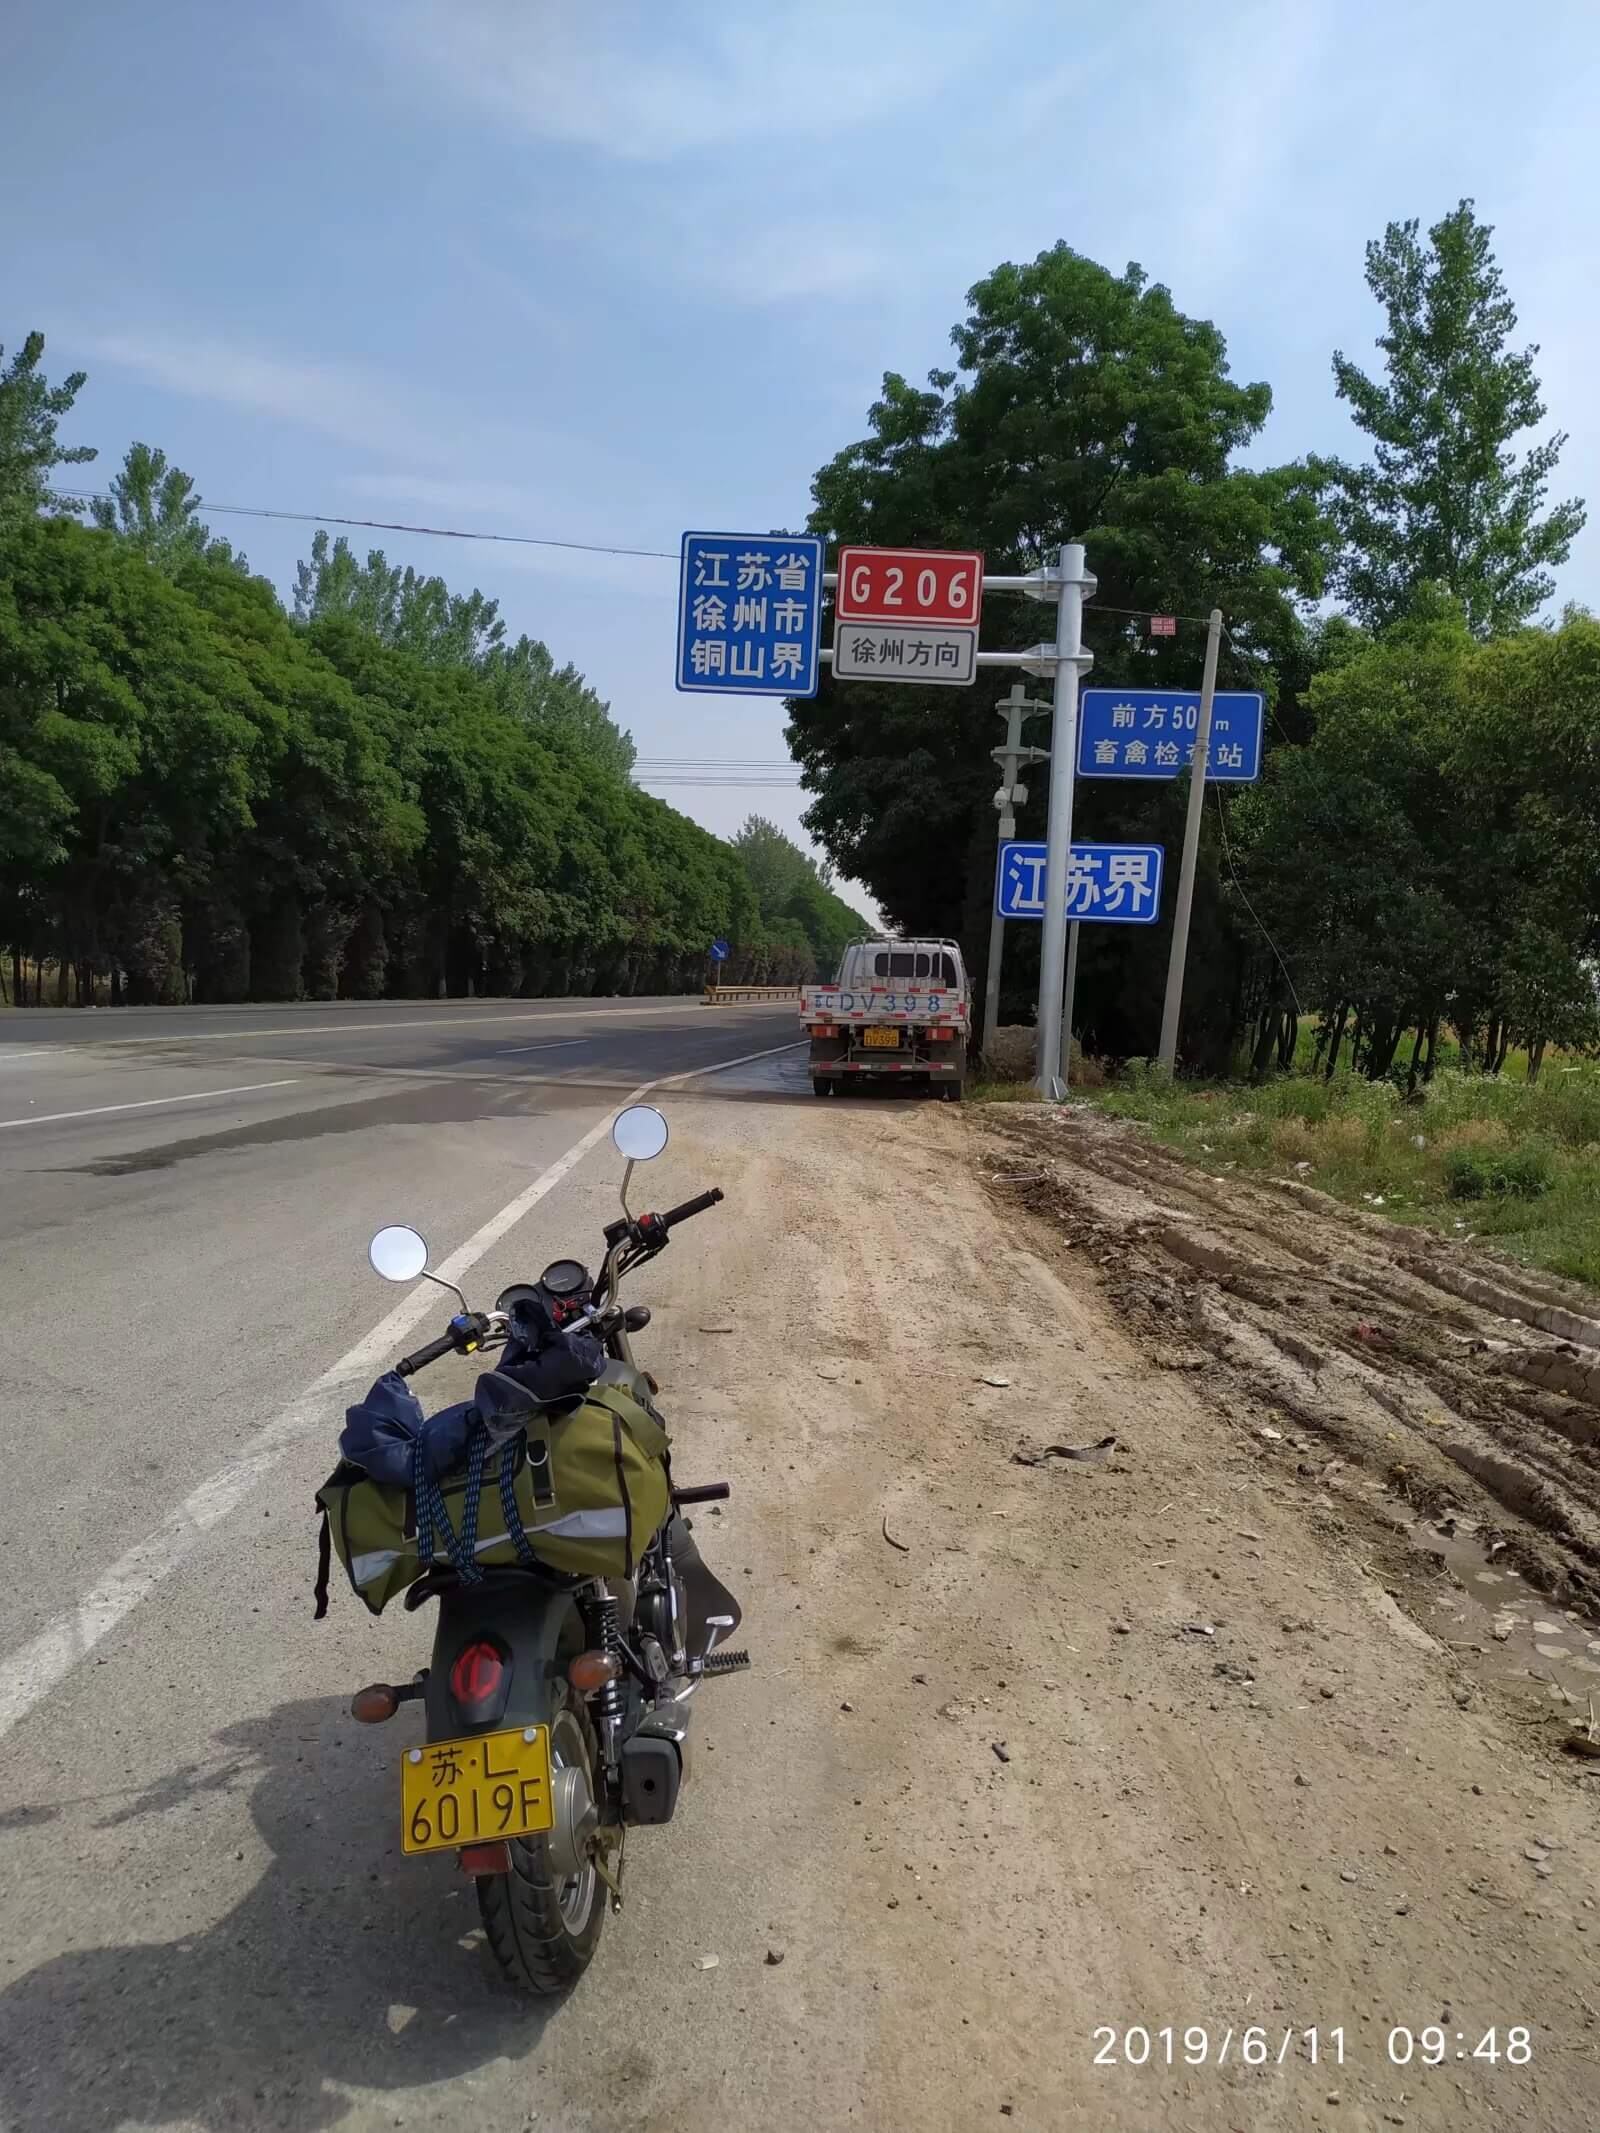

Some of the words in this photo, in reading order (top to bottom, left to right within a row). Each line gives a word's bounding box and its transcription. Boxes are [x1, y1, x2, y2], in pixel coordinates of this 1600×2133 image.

[694, 549, 811, 592] 江苏省
[850, 565, 967, 609] G206
[692, 594, 809, 635] 徐州市
[690, 638, 805, 681] 铜山界
[851, 637, 961, 668] 徐州方向
[1111, 702, 1230, 731] 前方50m
[1009, 852, 1153, 913] 江苏界
[411, 1777, 542, 1844] 6019F
